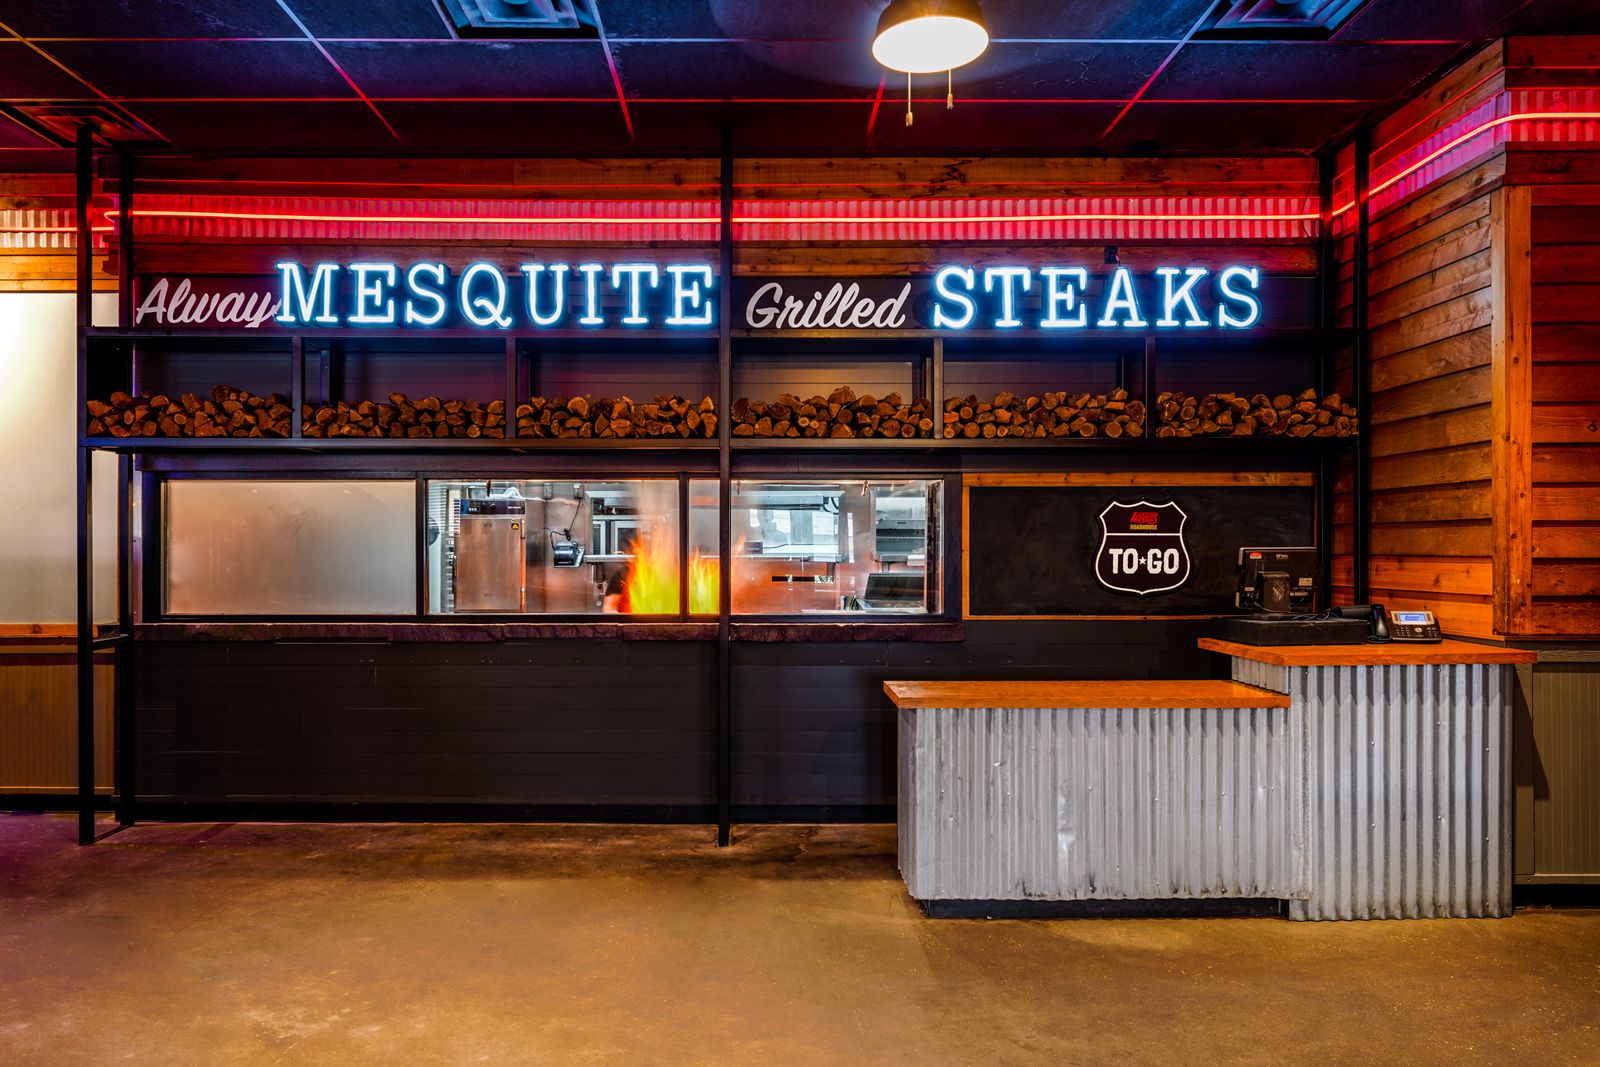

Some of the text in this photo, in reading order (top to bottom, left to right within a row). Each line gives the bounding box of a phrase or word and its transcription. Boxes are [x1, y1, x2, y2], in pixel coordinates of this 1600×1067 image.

[276, 262, 713, 328] MESQUITE
[745, 282, 912, 329] Grilled
[933, 265, 1260, 328] STEAKS
